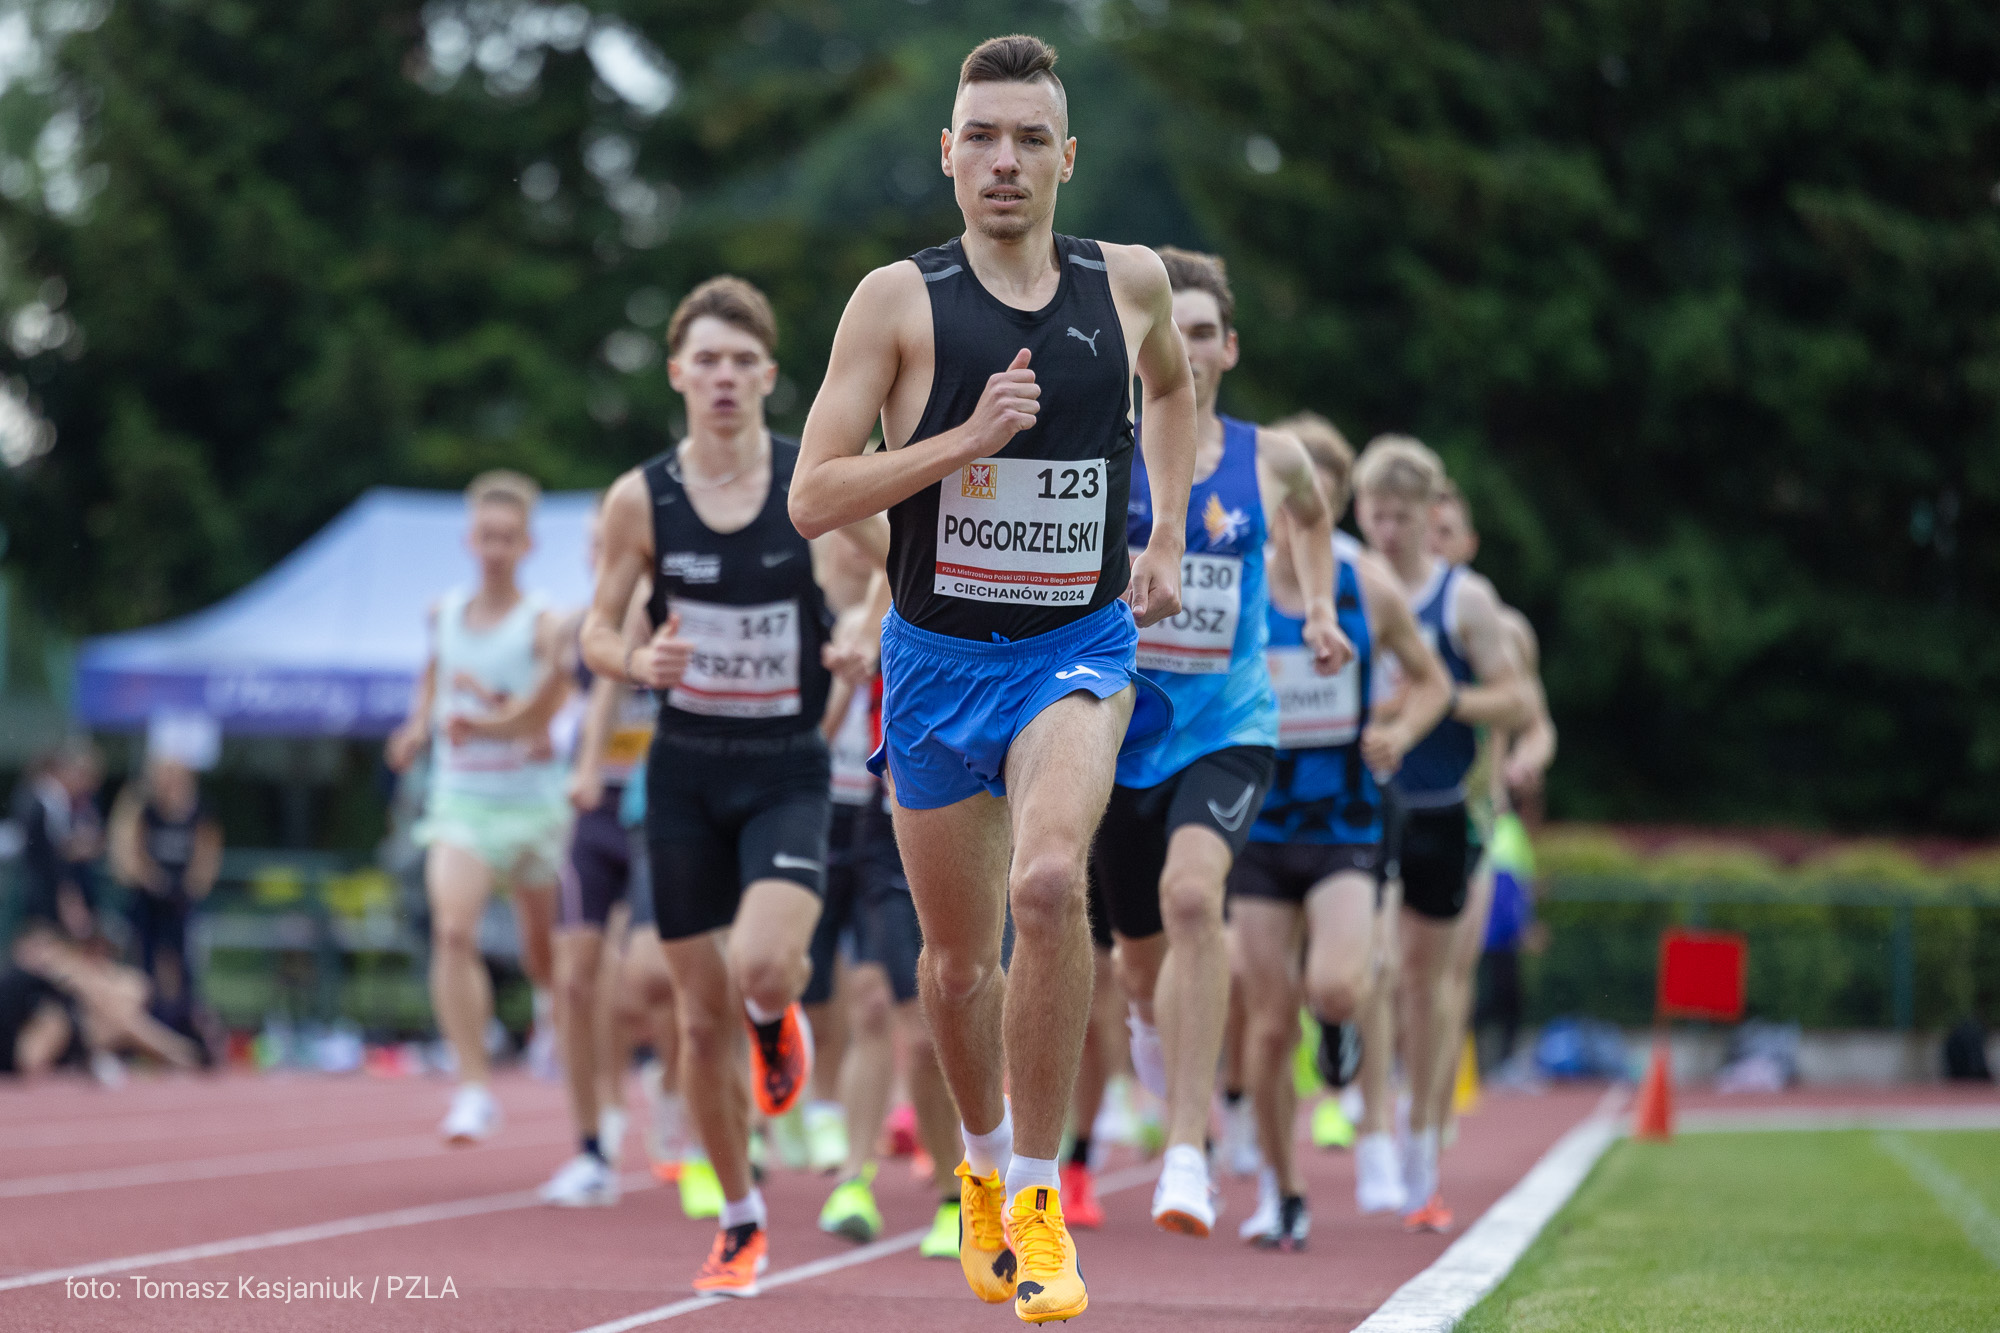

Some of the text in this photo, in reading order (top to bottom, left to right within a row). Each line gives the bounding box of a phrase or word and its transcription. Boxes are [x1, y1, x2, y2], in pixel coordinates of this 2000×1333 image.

[963, 485, 994, 498] PZLA
[1037, 467, 1099, 499] 123
[944, 514, 1099, 554] POGORZELSKI
[942, 566, 957, 574] PZLA
[957, 568, 993, 580] Mistrzostwa
[1050, 577, 1068, 585] Biegu
[1076, 575, 1091, 583] 5000
[1183, 563, 1232, 590] 130
[953, 582, 1085, 602] CIECHANÓW 2024
[741, 613, 788, 640] 147
